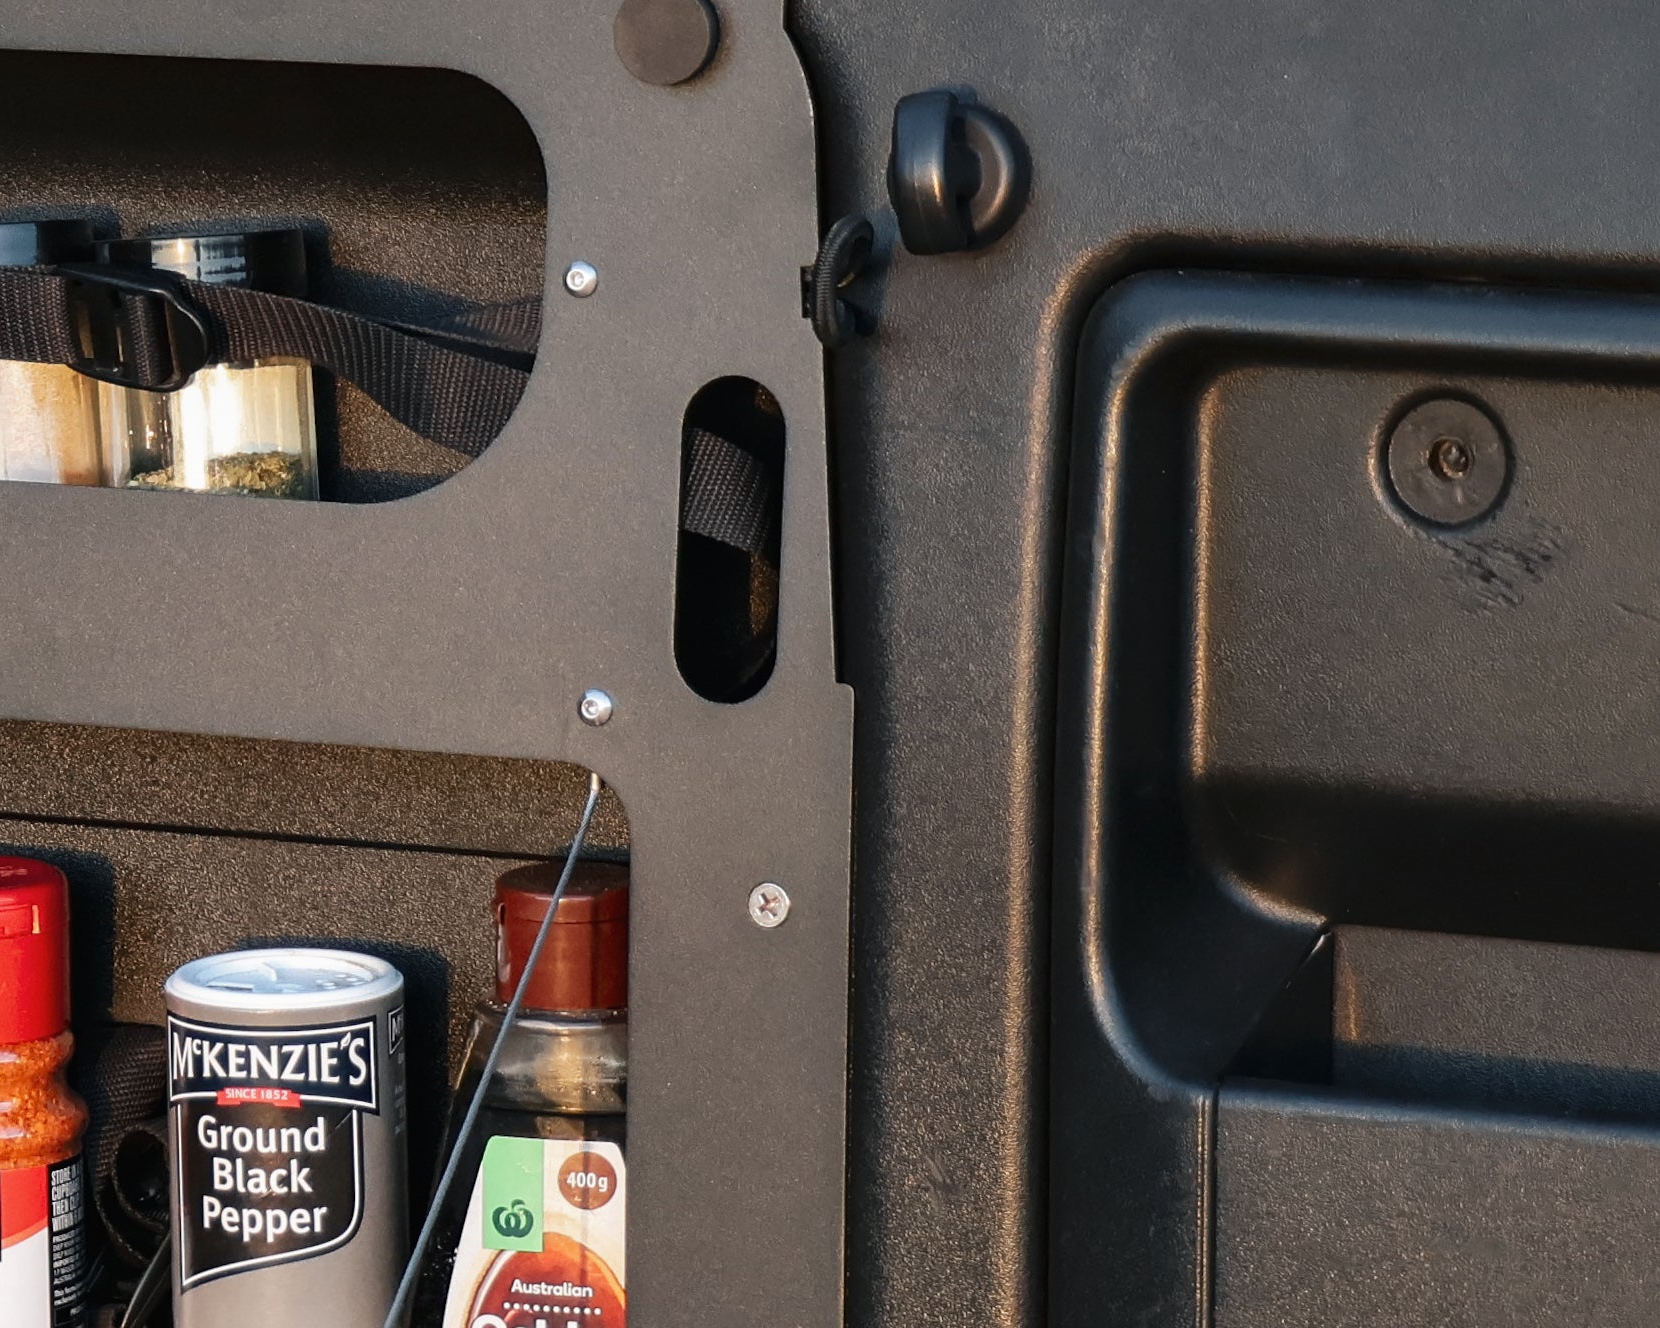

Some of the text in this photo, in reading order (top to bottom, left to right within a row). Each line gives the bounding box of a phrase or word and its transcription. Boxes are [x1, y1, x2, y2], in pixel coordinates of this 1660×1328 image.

[226, 1087, 289, 1100] SINCE 1852
[197, 1114, 326, 1153] Ground
[213, 1157, 313, 1194] Black
[202, 1195, 327, 1242] Pepper
[511, 1279, 593, 1298] Australian
